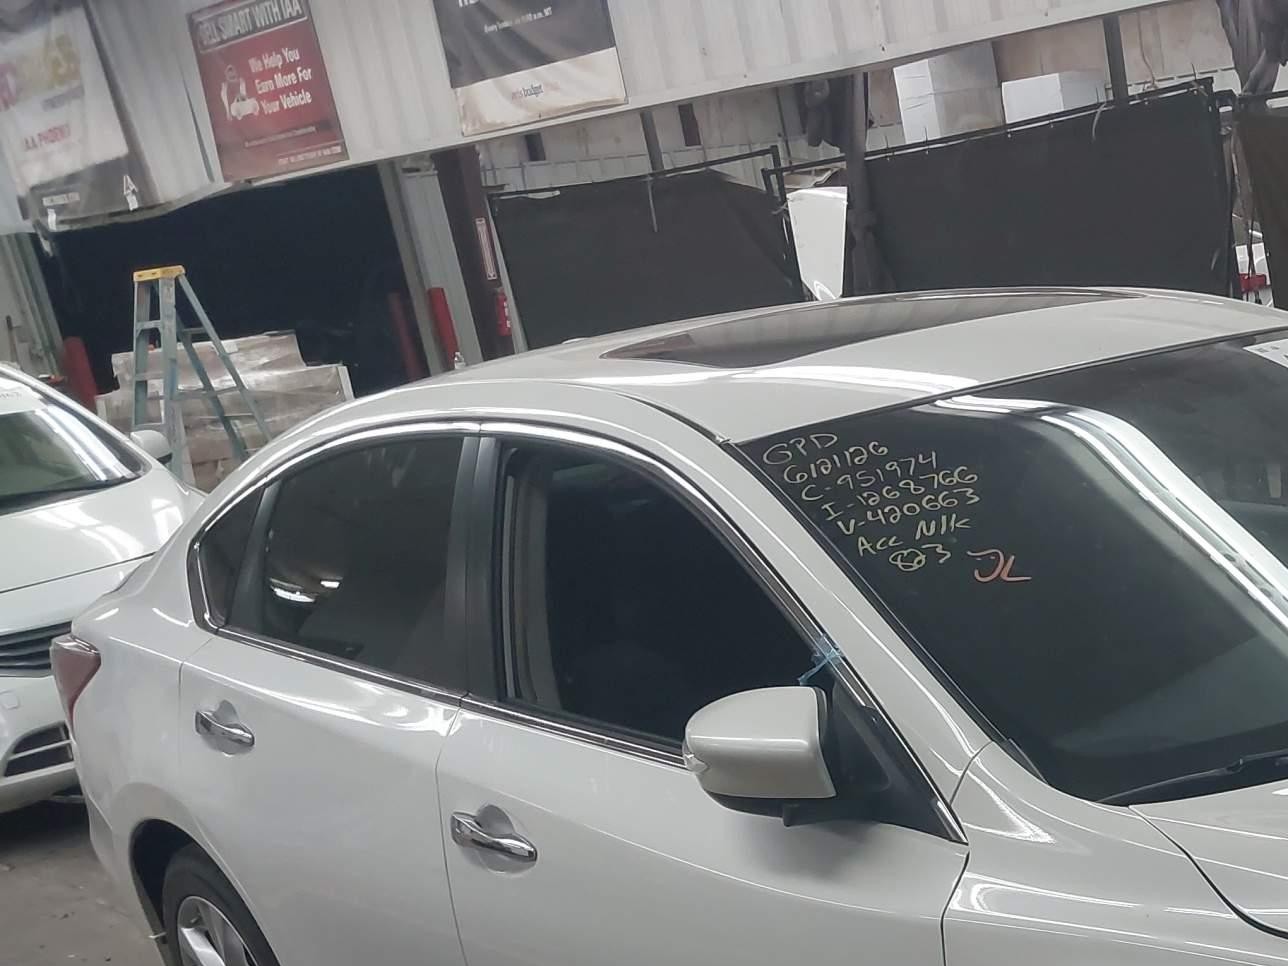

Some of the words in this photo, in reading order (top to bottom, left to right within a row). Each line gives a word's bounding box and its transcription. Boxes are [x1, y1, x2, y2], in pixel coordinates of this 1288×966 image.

[253, 1, 283, 28] WITH
[281, 0, 303, 18] IAA
[248, 57, 264, 73] We
[263, 52, 284, 72] Help
[283, 47, 300, 63] You
[254, 78, 275, 95] Earn
[273, 72, 298, 90] More
[297, 66, 313, 83] For
[261, 98, 281, 116] Your
[280, 88, 313, 109] Vehicle
[763, 433, 838, 466] GPD
